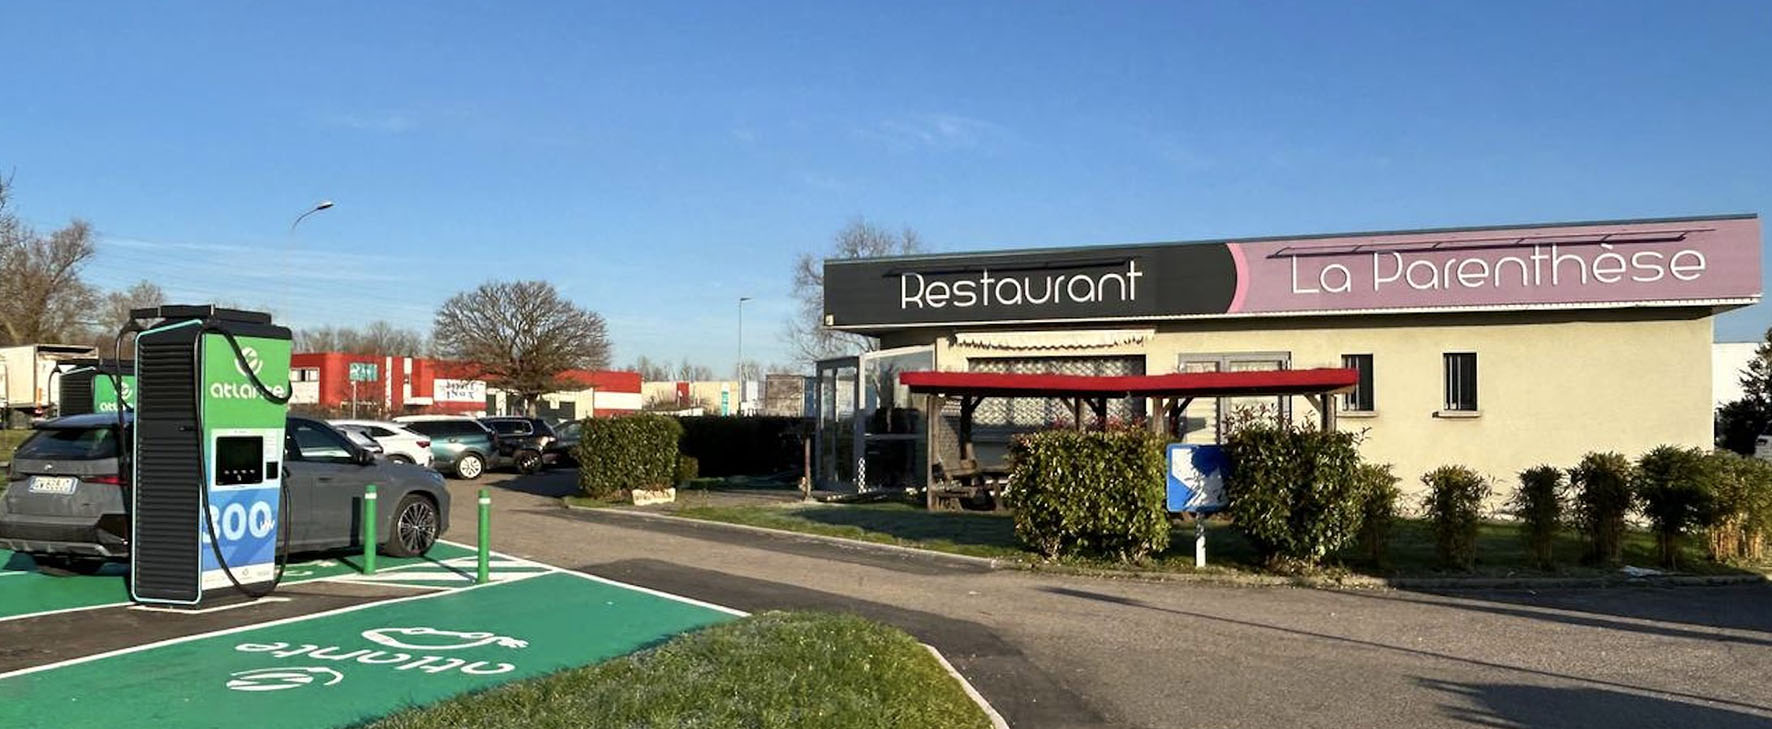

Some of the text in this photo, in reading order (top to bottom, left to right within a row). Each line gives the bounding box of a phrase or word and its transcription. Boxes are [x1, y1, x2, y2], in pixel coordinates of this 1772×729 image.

[900, 243, 1707, 309] Restaurant La Parenthèse
[234, 642, 516, 675] atlante
